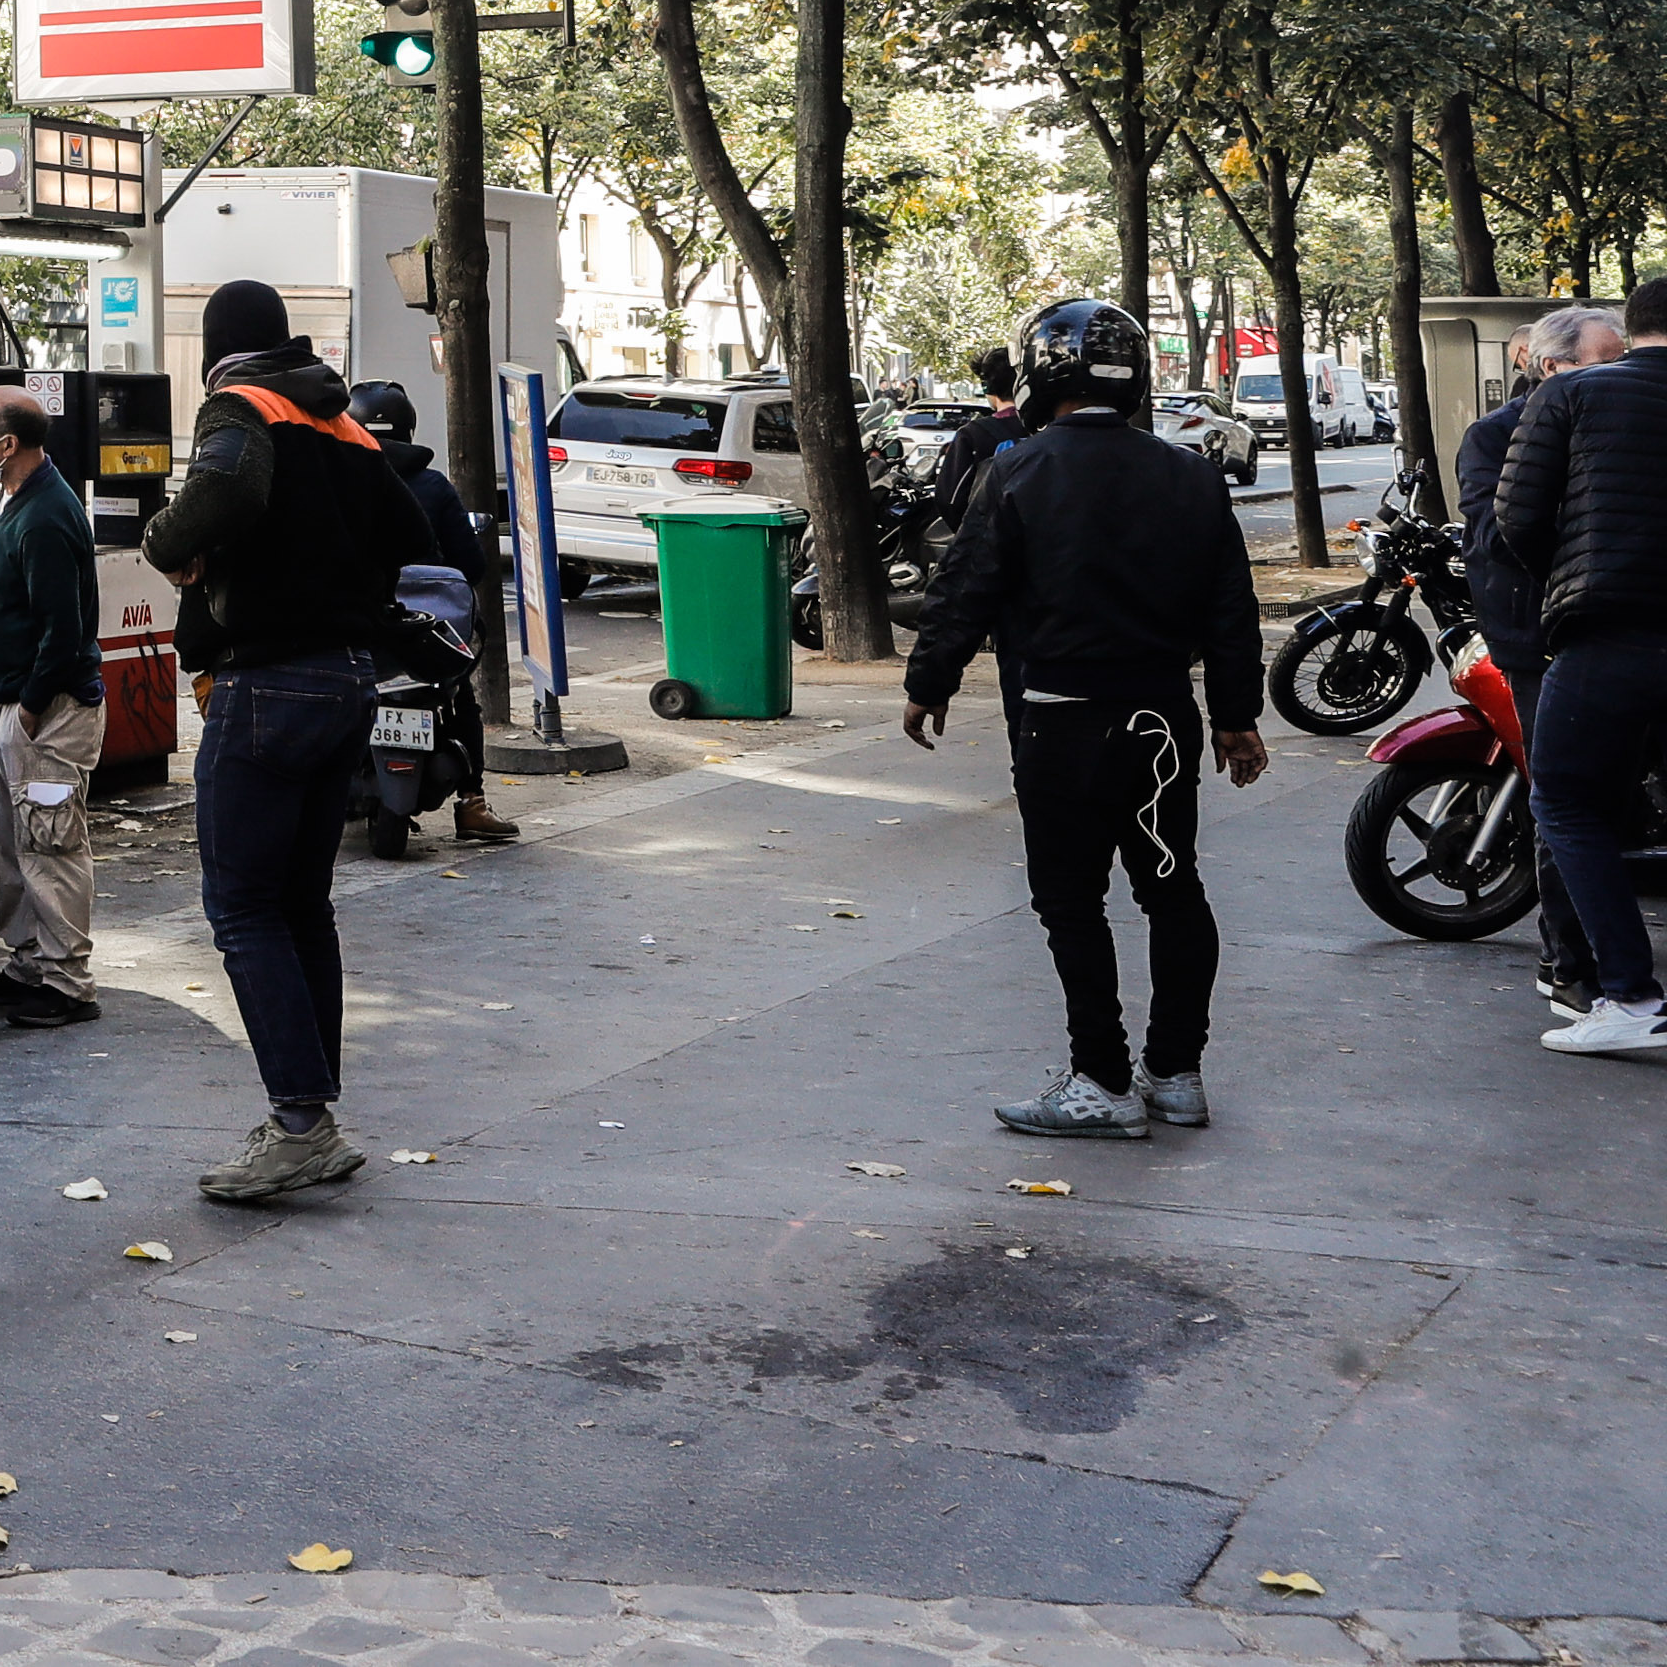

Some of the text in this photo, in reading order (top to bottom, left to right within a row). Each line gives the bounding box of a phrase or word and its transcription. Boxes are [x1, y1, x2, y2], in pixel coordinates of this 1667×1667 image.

[292, 191, 336, 199] VIVIER
[606, 449, 632, 461] Jeep
[122, 599, 152, 628] AVIA
